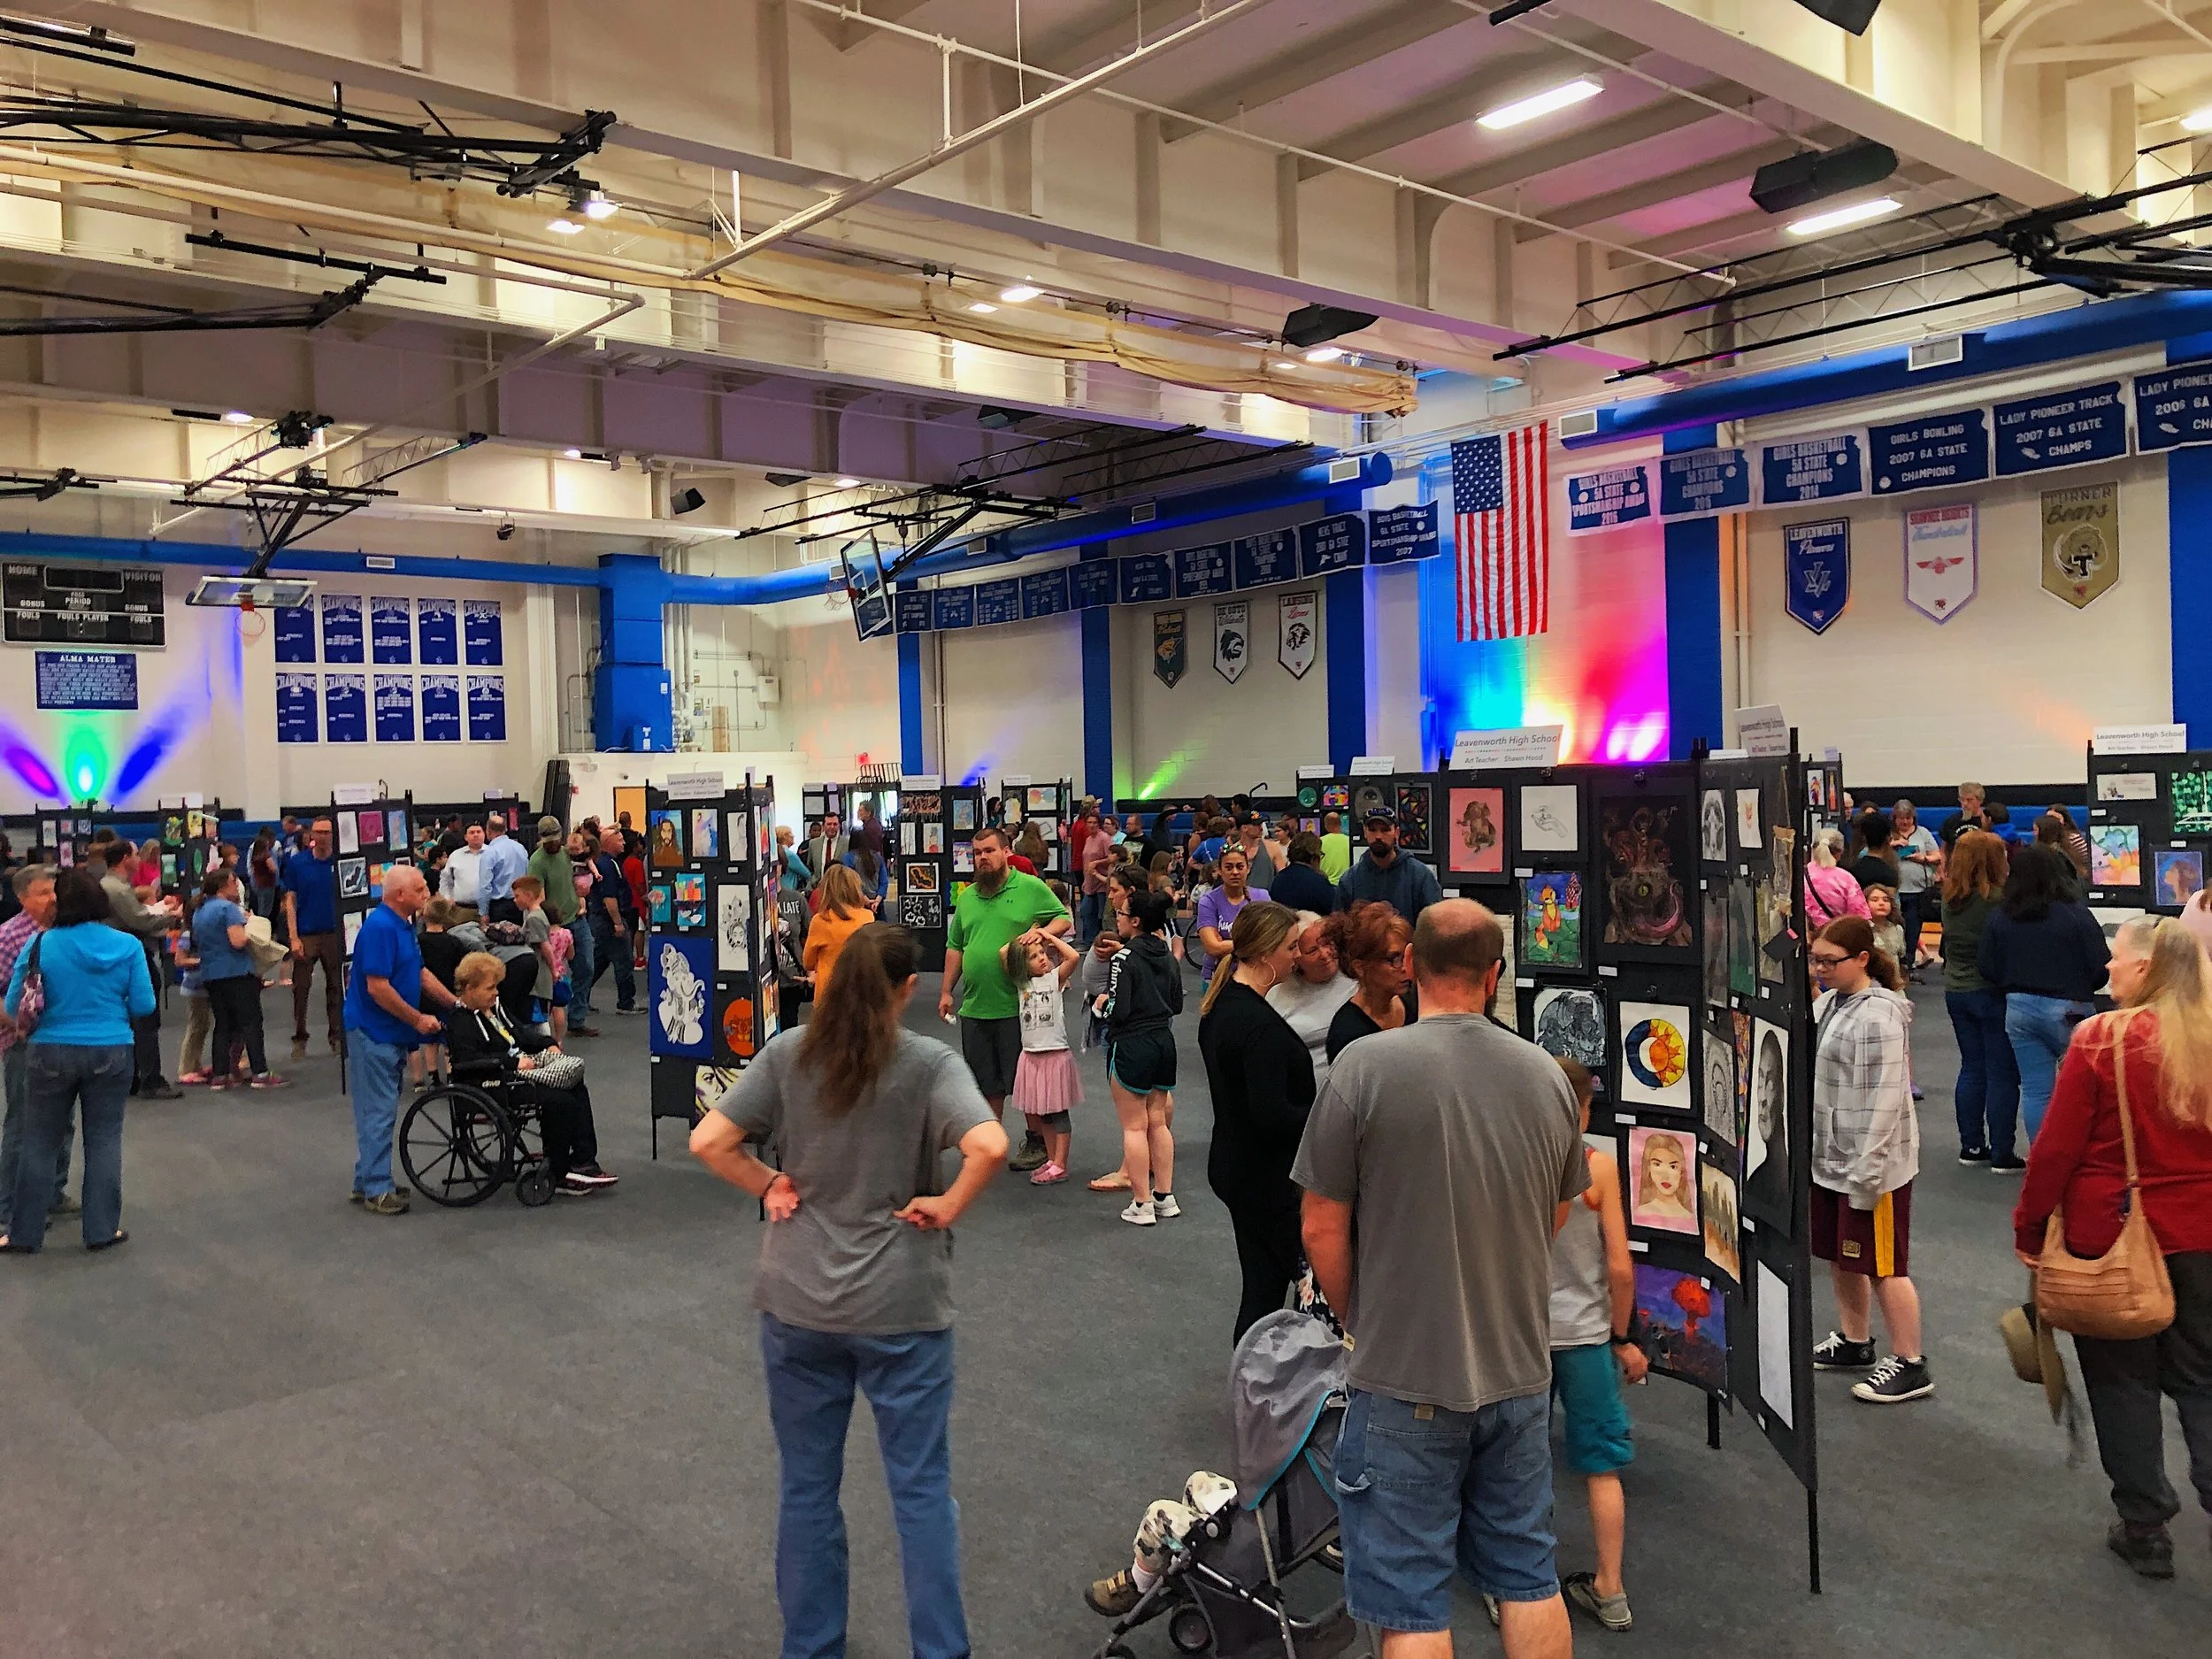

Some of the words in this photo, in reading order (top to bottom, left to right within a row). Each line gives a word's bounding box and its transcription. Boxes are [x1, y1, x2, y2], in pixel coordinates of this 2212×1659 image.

[2139, 380, 2168, 396] LADY
[2000, 411, 2026, 426] LADY
[2031, 403, 2075, 421] PIONEER
[2079, 394, 2113, 411] TRACK
[1890, 430, 1918, 445] GIRLS
[1923, 424, 1964, 438] BOWLING
[2016, 429, 2043, 443] 2007
[2068, 418, 2102, 434] STATE
[1797, 436, 1847, 457] BASKETBALL
[1889, 451, 1915, 465] 2007
[1938, 443, 1968, 457] STATE
[2048, 440, 2093, 457] CHAMPS
[1803, 454, 1828, 470] STATE
[1786, 468, 1833, 488] CHAMPIONS
[1901, 465, 1955, 482] CHAMPIONS
[2048, 487, 2113, 504] TURNER
[2047, 504, 2110, 525] Bears
[1790, 523, 1844, 541] LEAVENWORTH
[8, 565, 38, 575] HOME
[124, 572, 162, 582] VISITOR
[65, 596, 91, 605] PERIOD
[1455, 736, 1507, 748] Leavenworth
[1509, 736, 1529, 747] High
[1531, 733, 1560, 743] School
[783, 901, 801, 914] LATE
